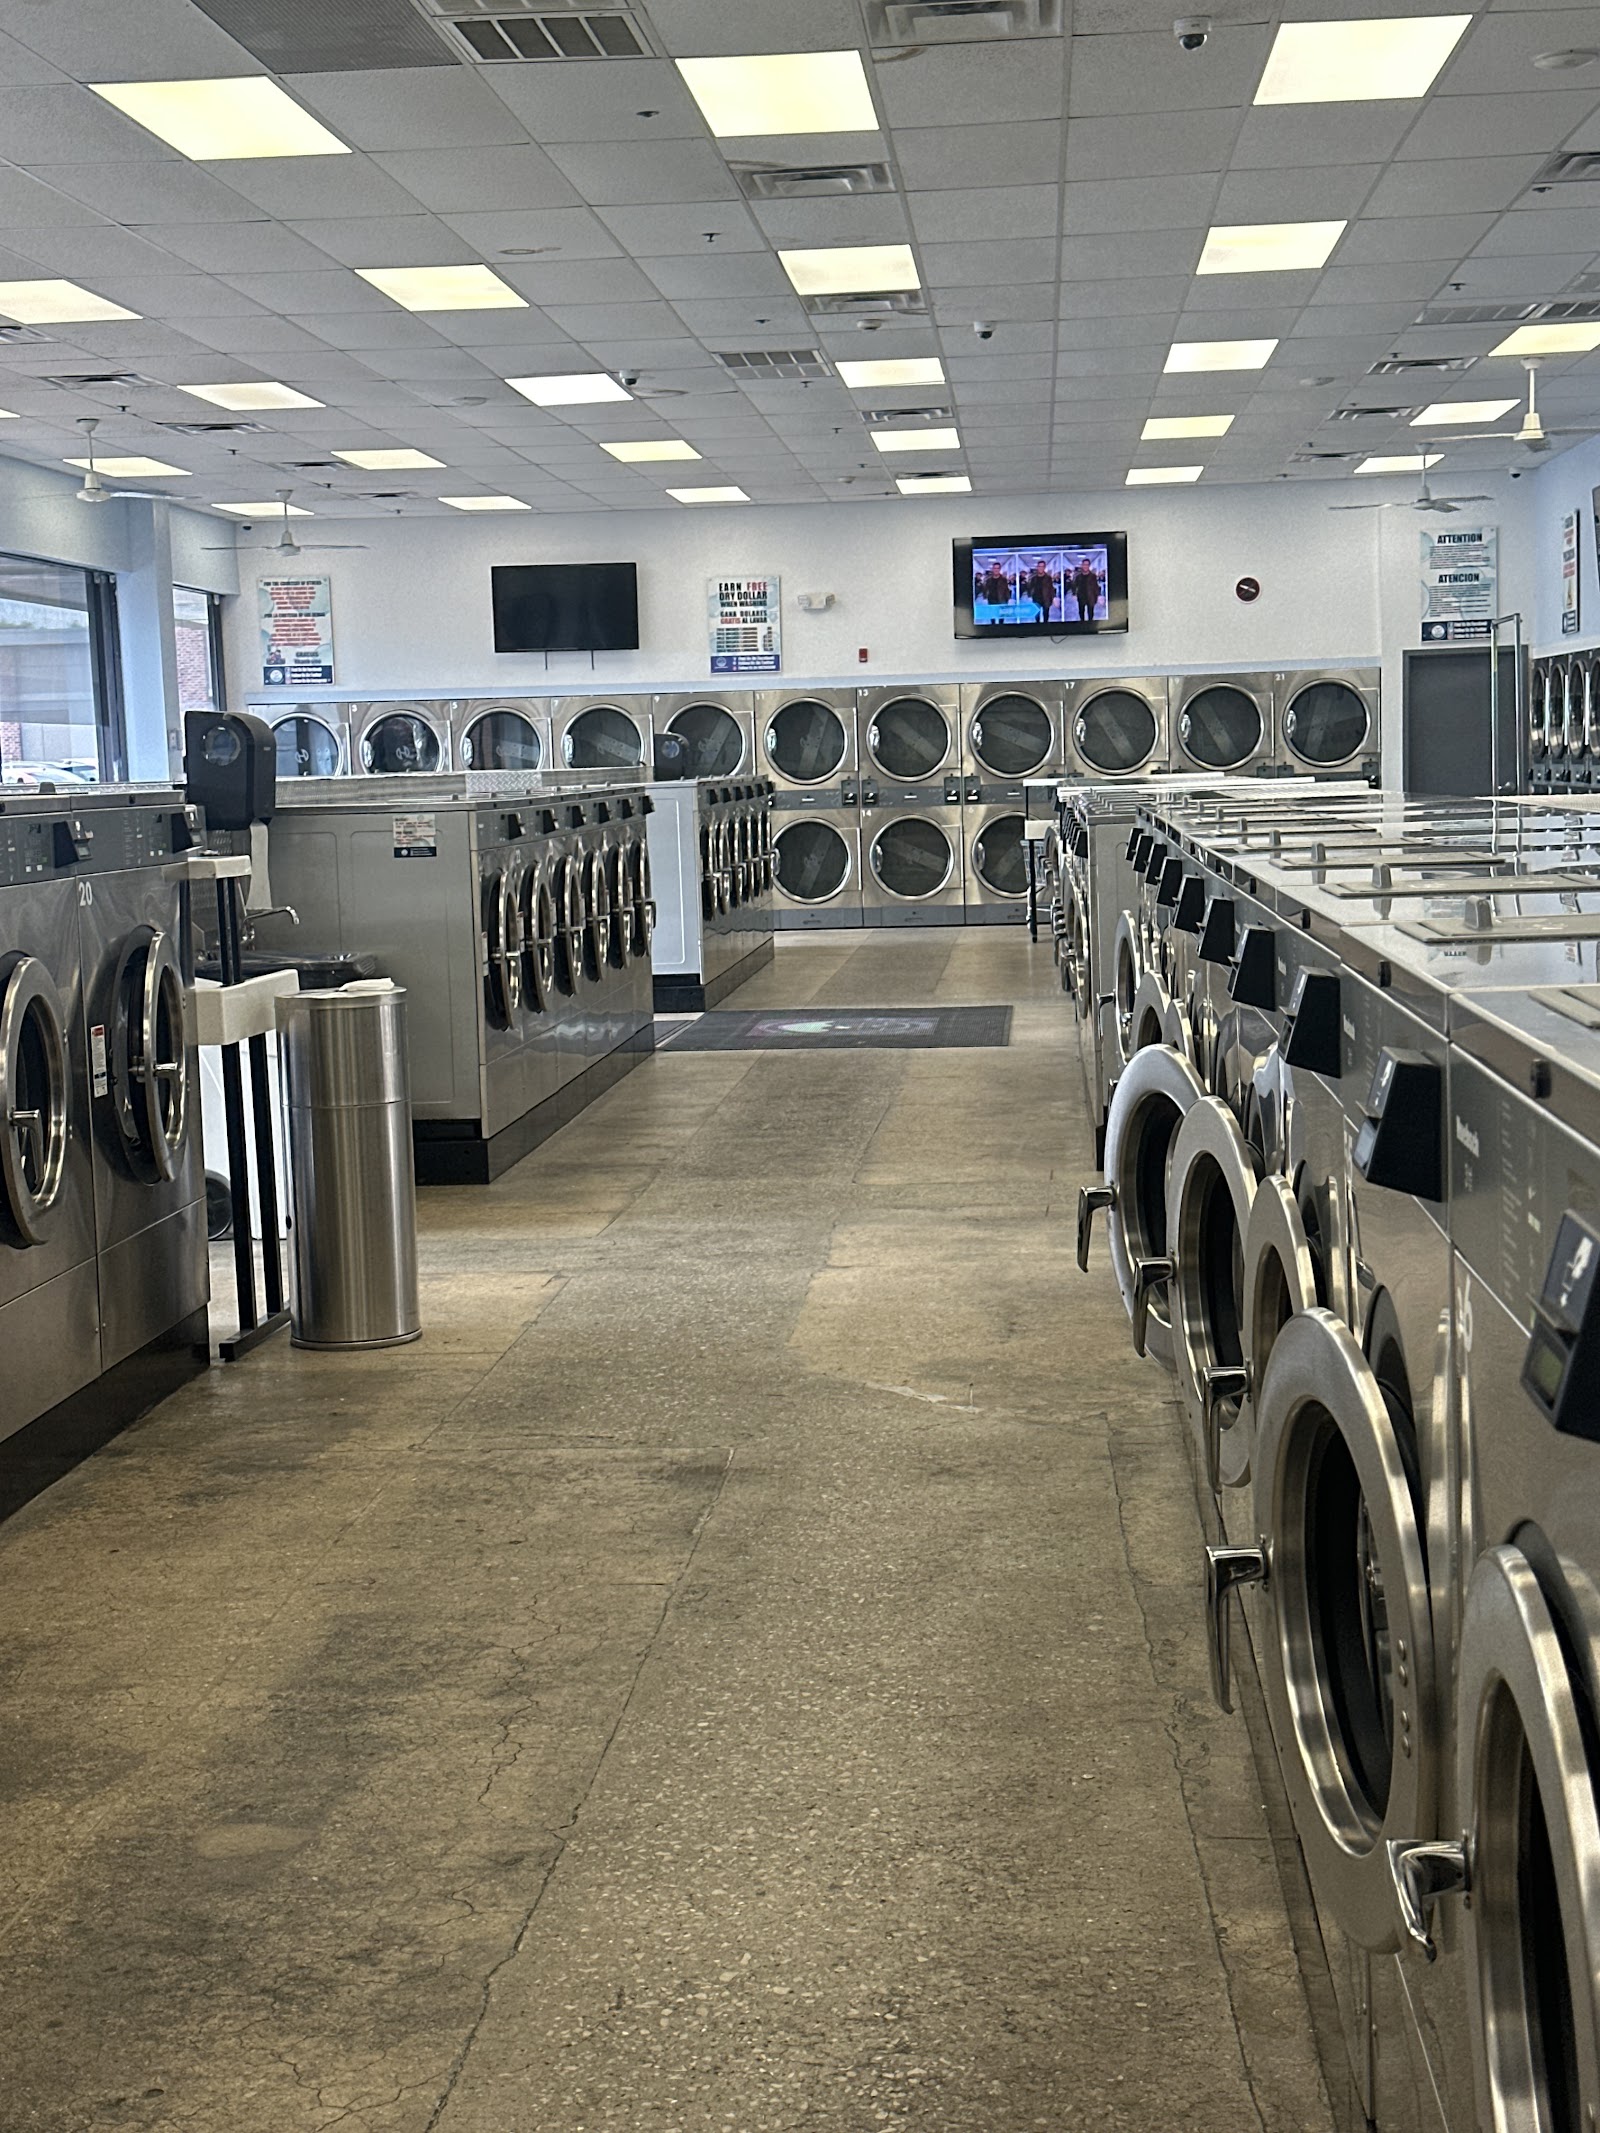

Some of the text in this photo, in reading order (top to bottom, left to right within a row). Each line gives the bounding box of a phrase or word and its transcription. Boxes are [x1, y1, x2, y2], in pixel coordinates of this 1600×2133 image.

[1437, 533, 1483, 544] ATTENTION
[1438, 573, 1480, 584] ATENCION
[719, 581, 768, 592] EARN FREE
[719, 591, 768, 601] DRY DOLLAR
[858, 689, 869, 697] 13
[351, 704, 358, 712] 3
[452, 701, 458, 709] 5
[554, 699, 560, 707] 7
[78, 880, 93, 907] 20
